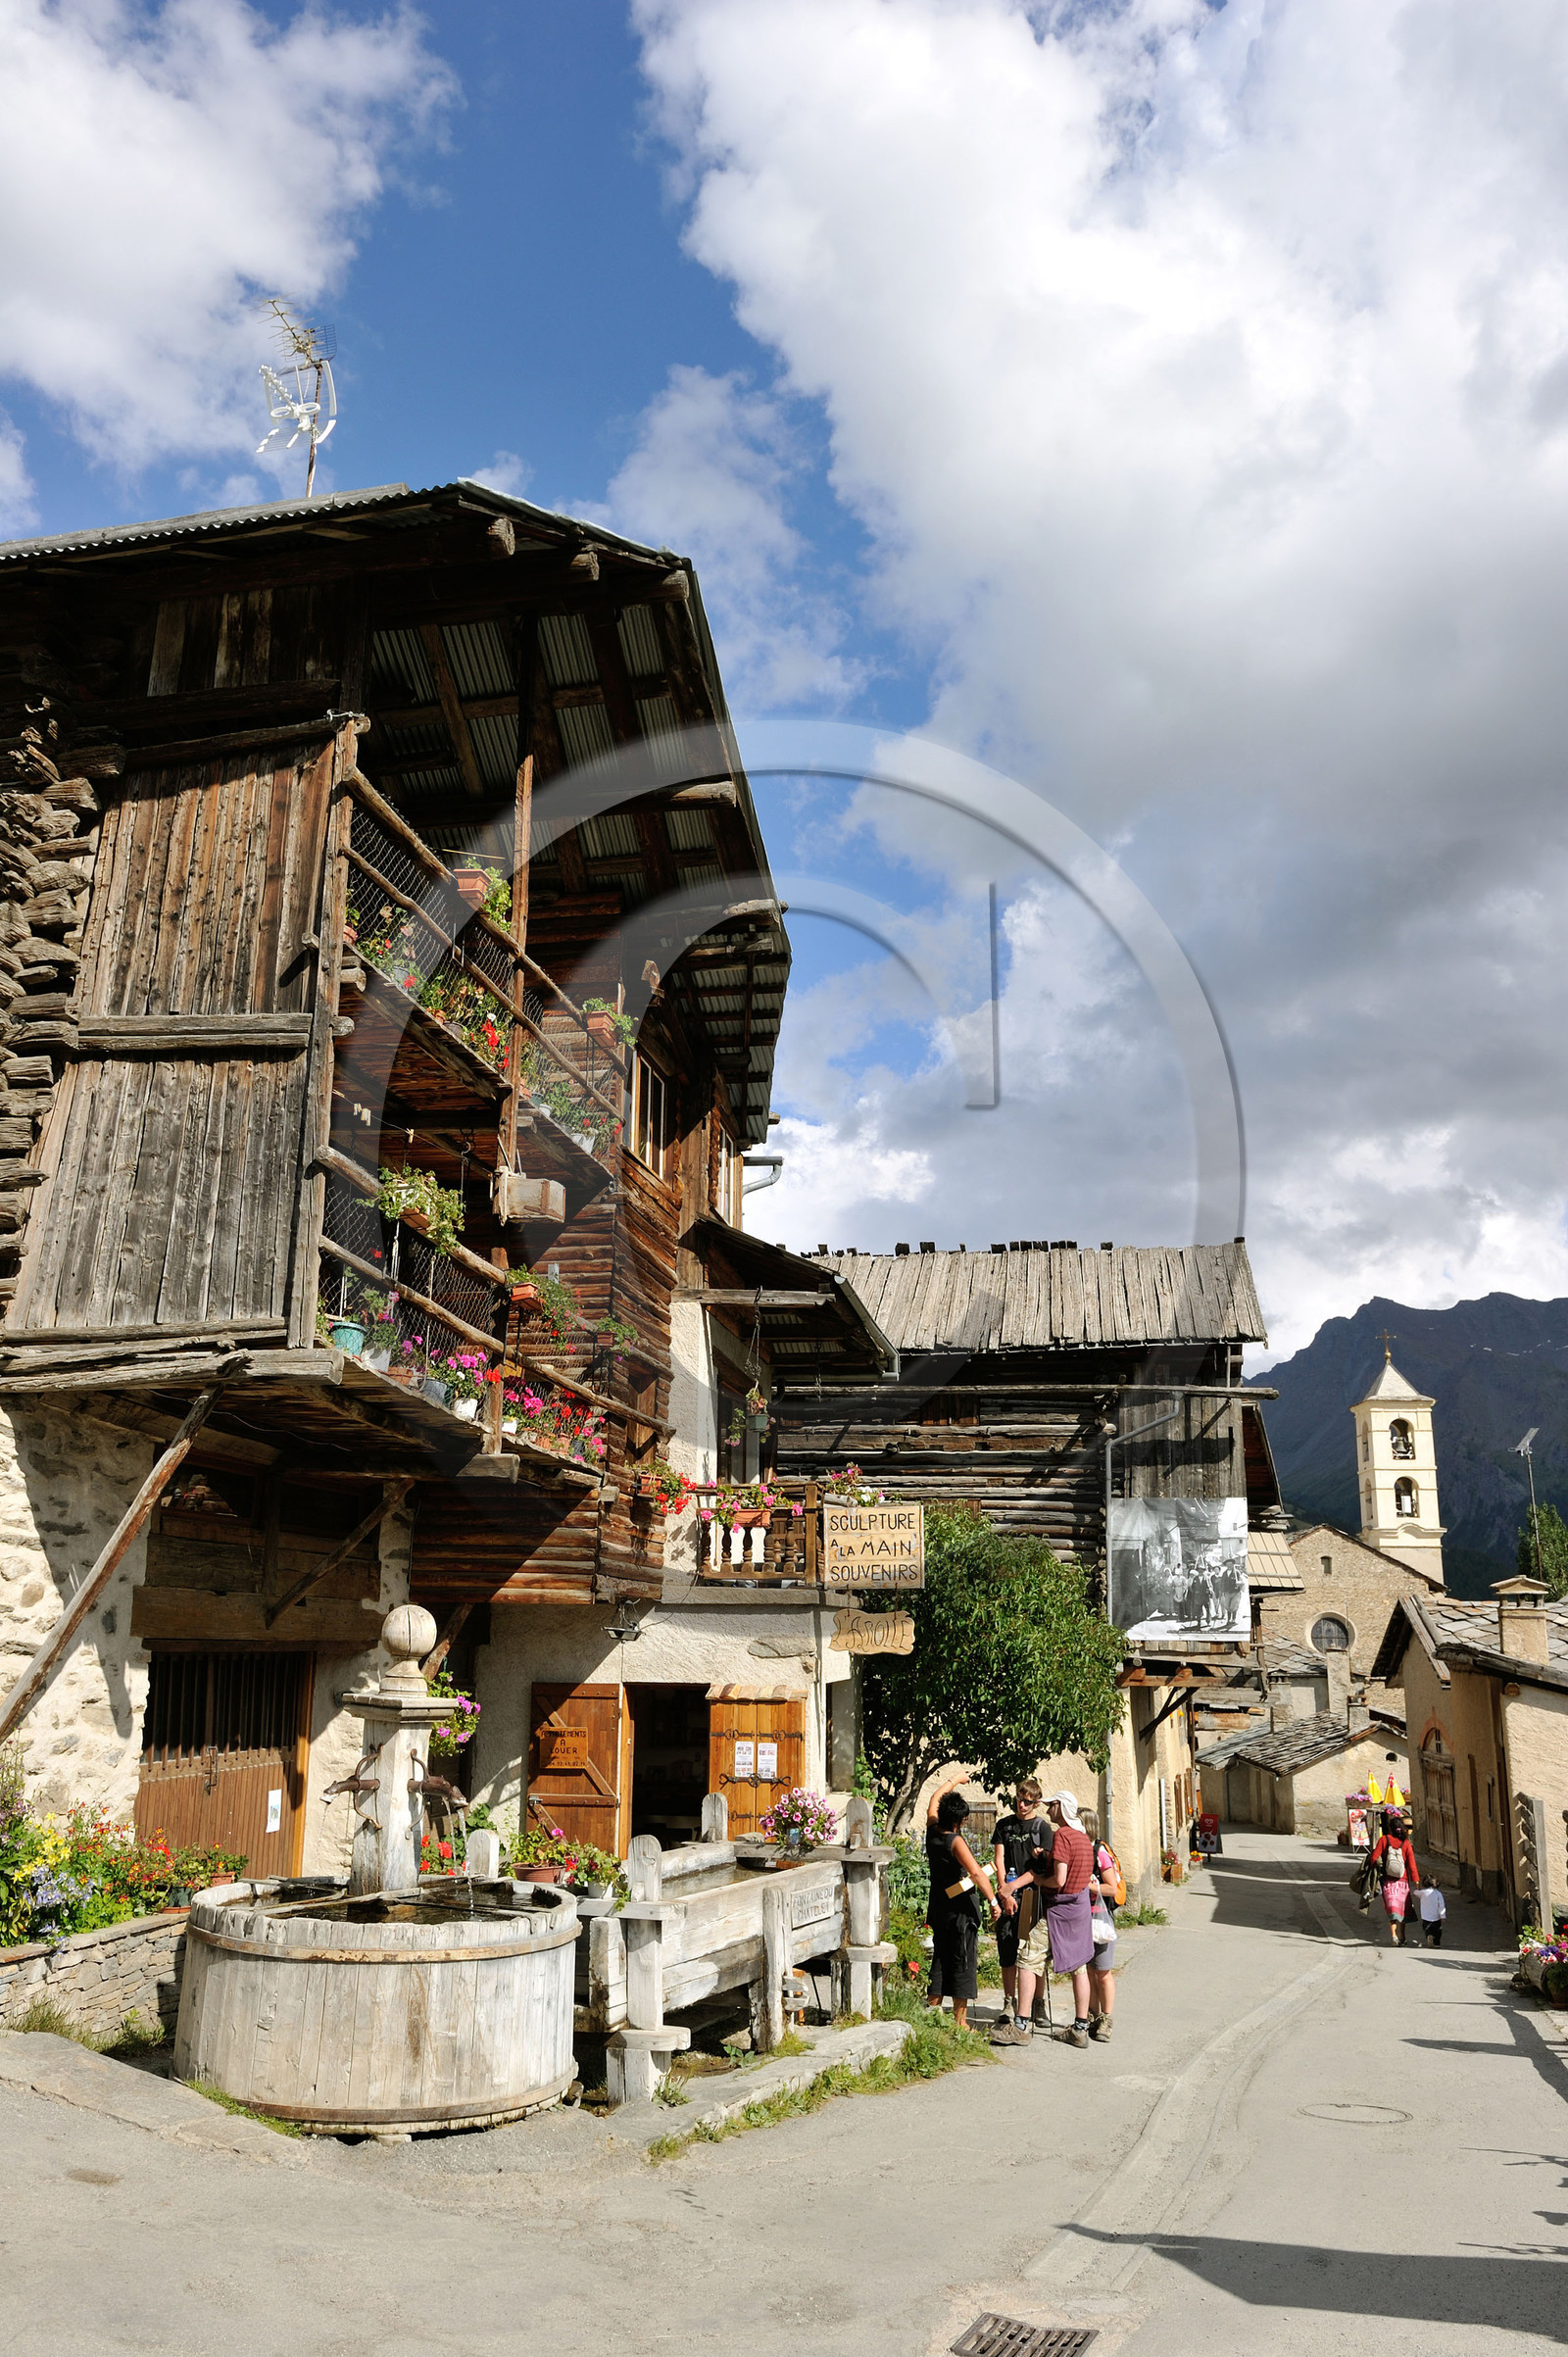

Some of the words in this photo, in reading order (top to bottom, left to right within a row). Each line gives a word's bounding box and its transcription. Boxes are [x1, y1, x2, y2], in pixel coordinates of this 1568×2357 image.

[830, 1512, 915, 1531] SCULPTURE
[840, 1547, 856, 1556] LA
[860, 1540, 911, 1556] MAIN
[830, 1564, 918, 1582] SOUVENIRS
